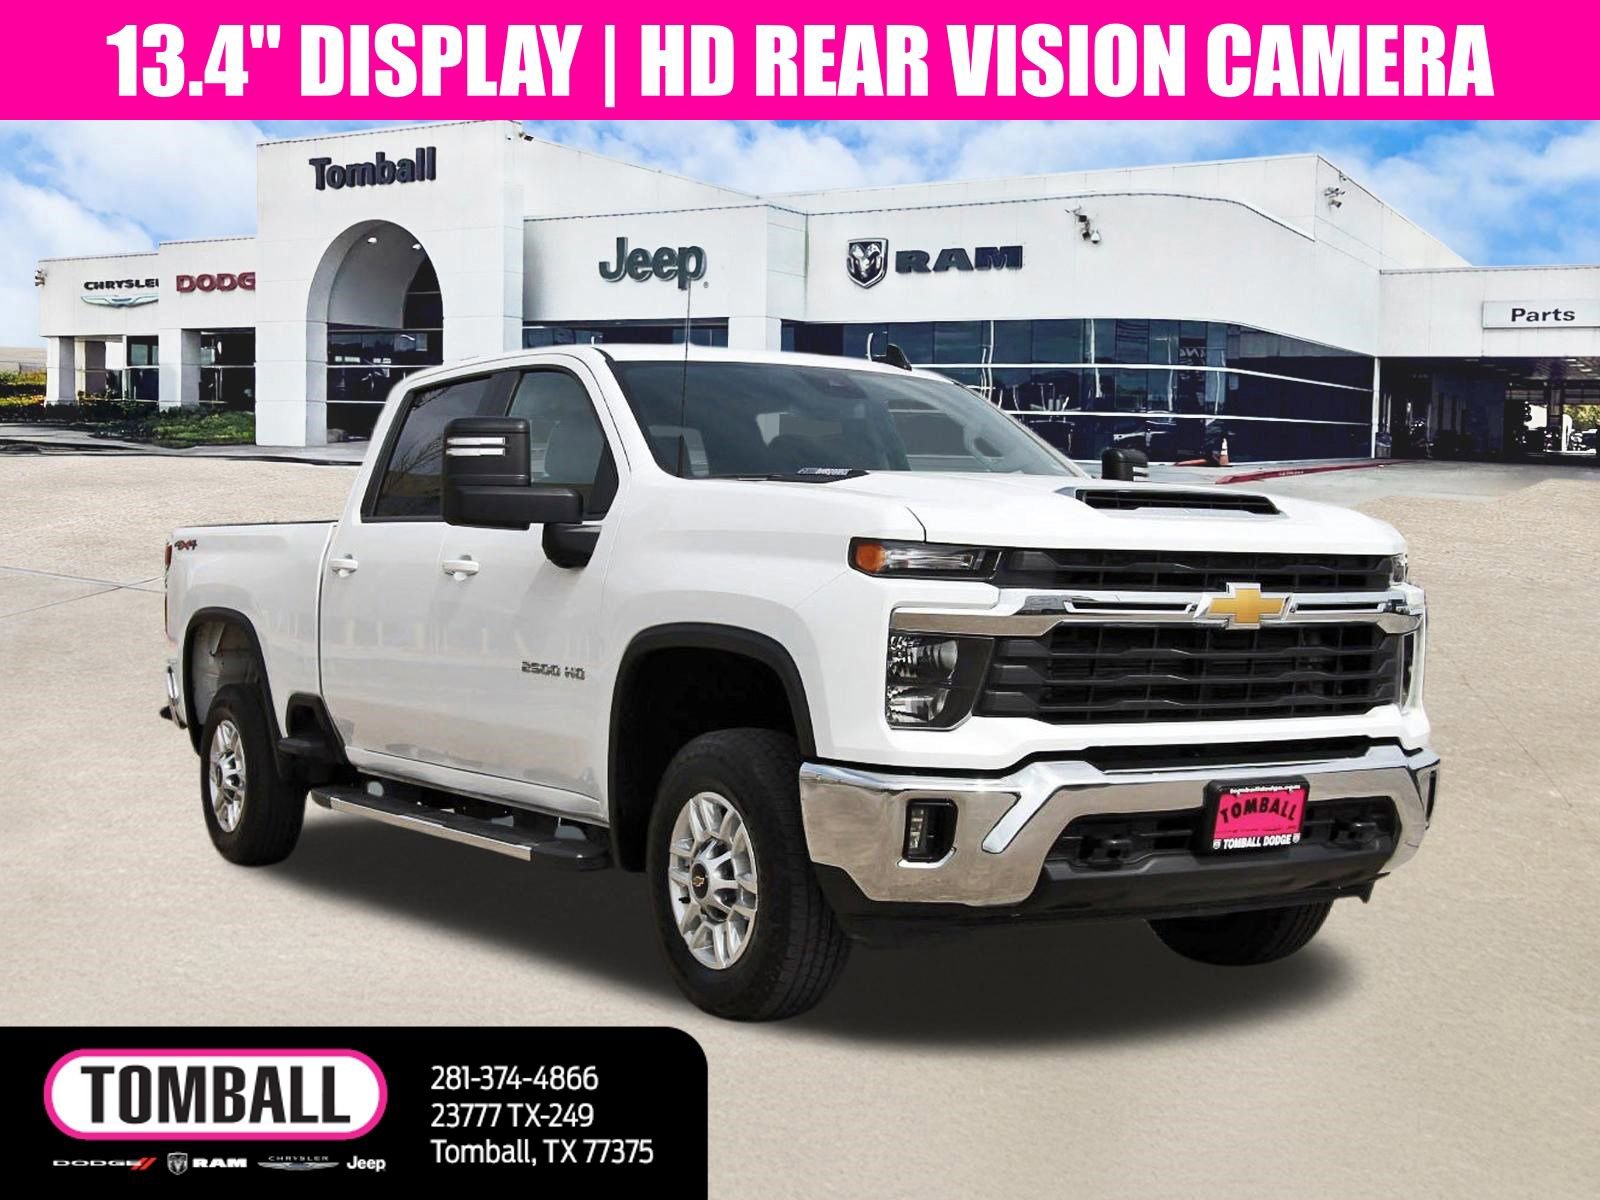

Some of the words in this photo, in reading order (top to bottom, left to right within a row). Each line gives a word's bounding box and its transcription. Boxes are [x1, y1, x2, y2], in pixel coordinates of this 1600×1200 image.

[309, 146, 437, 191] Tomball
[599, 236, 707, 289] Jeep
[895, 245, 1023, 274] RAM
[1511, 307, 1576, 322] Parts
[1220, 797, 1297, 824] TOMBALL
[1223, 836, 1262, 850] TOMBALL
[1263, 833, 1292, 847] DODGE
